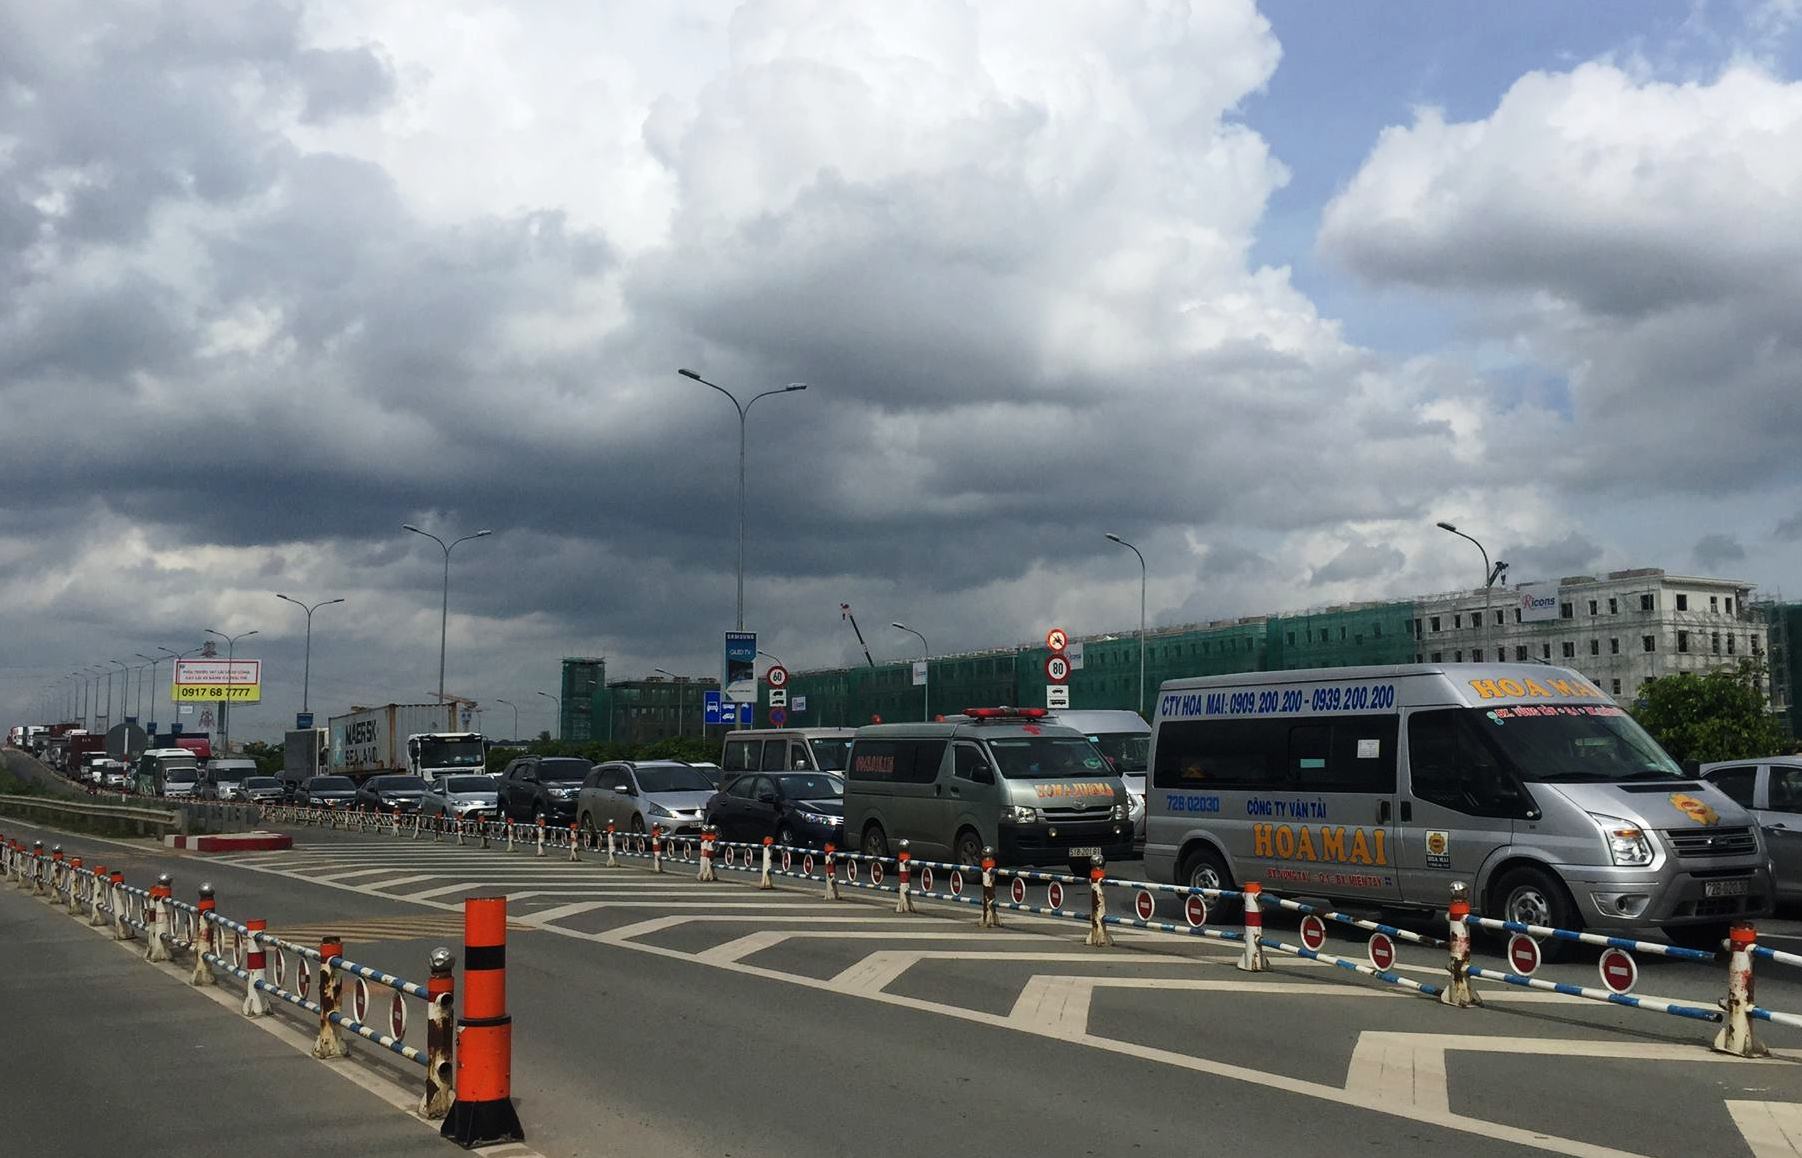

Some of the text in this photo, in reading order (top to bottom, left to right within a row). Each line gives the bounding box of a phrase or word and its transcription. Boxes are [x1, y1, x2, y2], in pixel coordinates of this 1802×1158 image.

[1522, 594, 1556, 608] Ricons
[773, 671, 782, 682] 60
[1052, 662, 1064, 676] 80
[181, 687, 250, 697] 0917 68 7777
[1470, 679, 1549, 698] HOA
[1161, 692, 1181, 716] CTY
[1181, 691, 1201, 715] HOA
[1230, 689, 1303, 714] 0909.200.200
[1312, 684, 1394, 712] 0939.200.200
[1247, 797, 1272, 816] CÔNG
[1274, 801, 1286, 816] TY
[1253, 823, 1388, 865] HOA MAI
